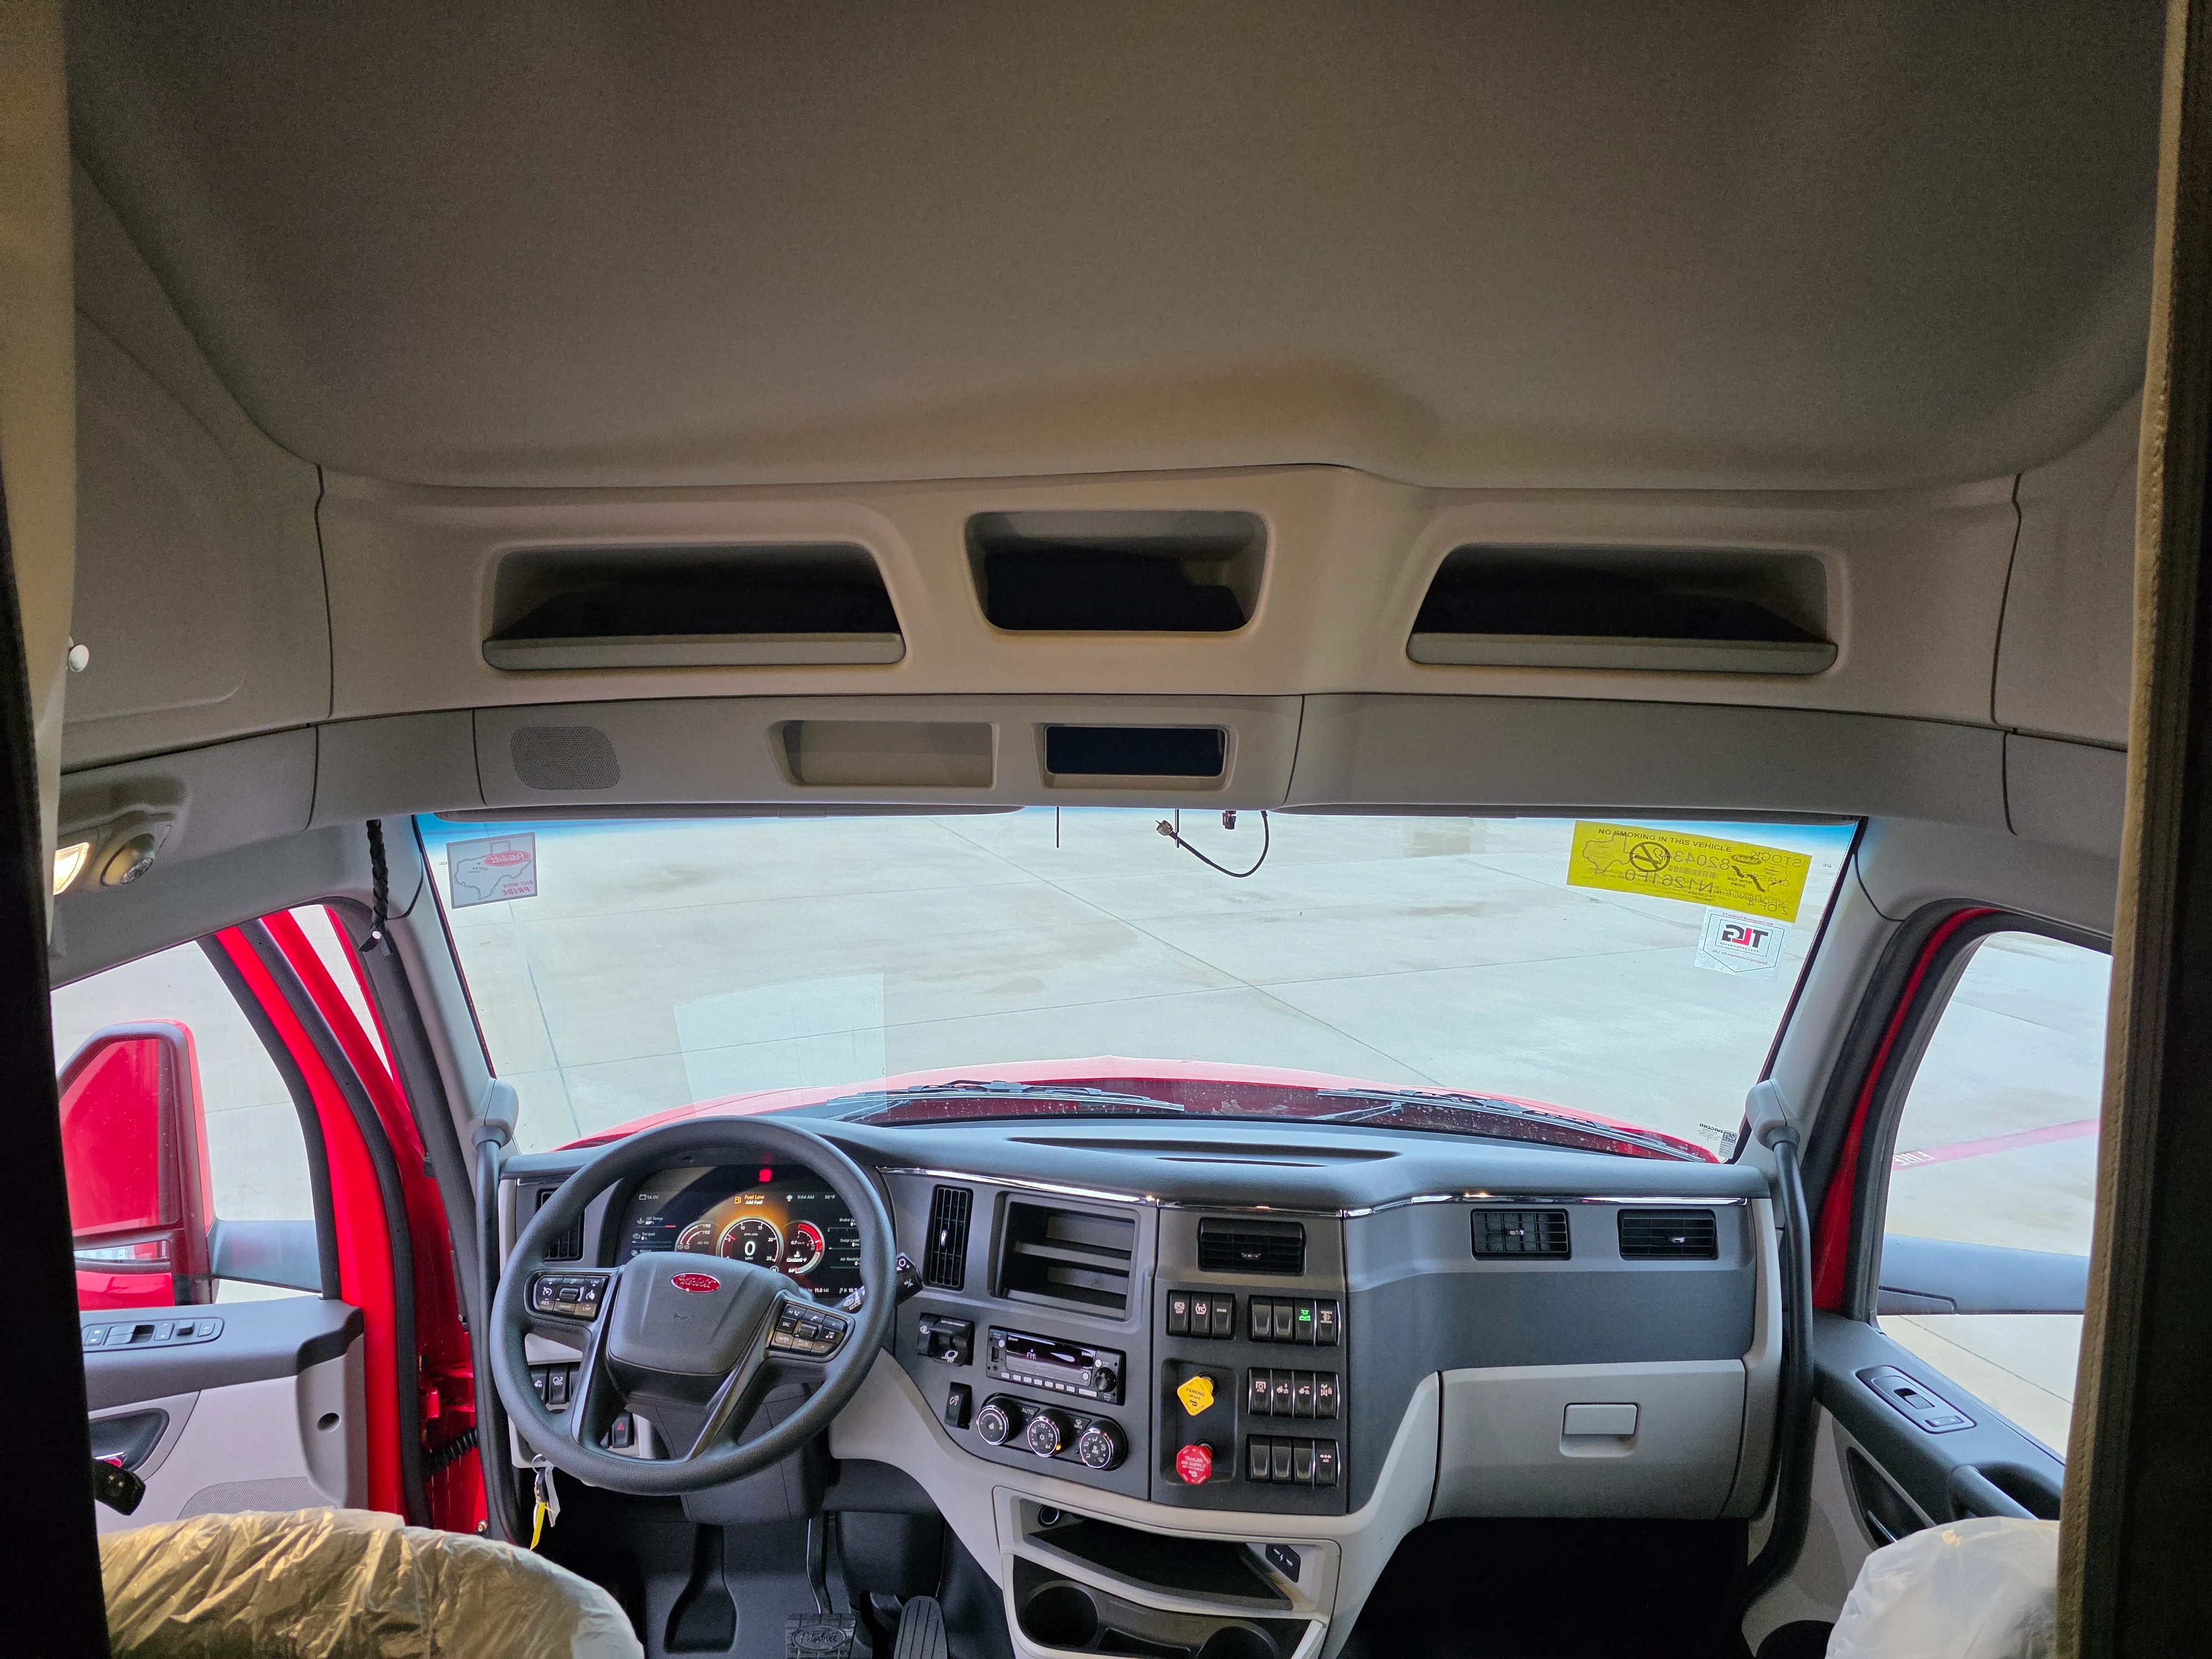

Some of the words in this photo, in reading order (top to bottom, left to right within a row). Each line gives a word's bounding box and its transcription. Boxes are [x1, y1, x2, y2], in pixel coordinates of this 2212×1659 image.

[1614, 830, 1656, 841] SMOKING
[1670, 837, 1690, 846] THIS
[1693, 841, 1733, 852] VEHICLE
[744, 1241, 755, 1256] 0
[675, 1274, 717, 1288] Peterbilt
[1186, 1387, 1205, 1397] PARKING
